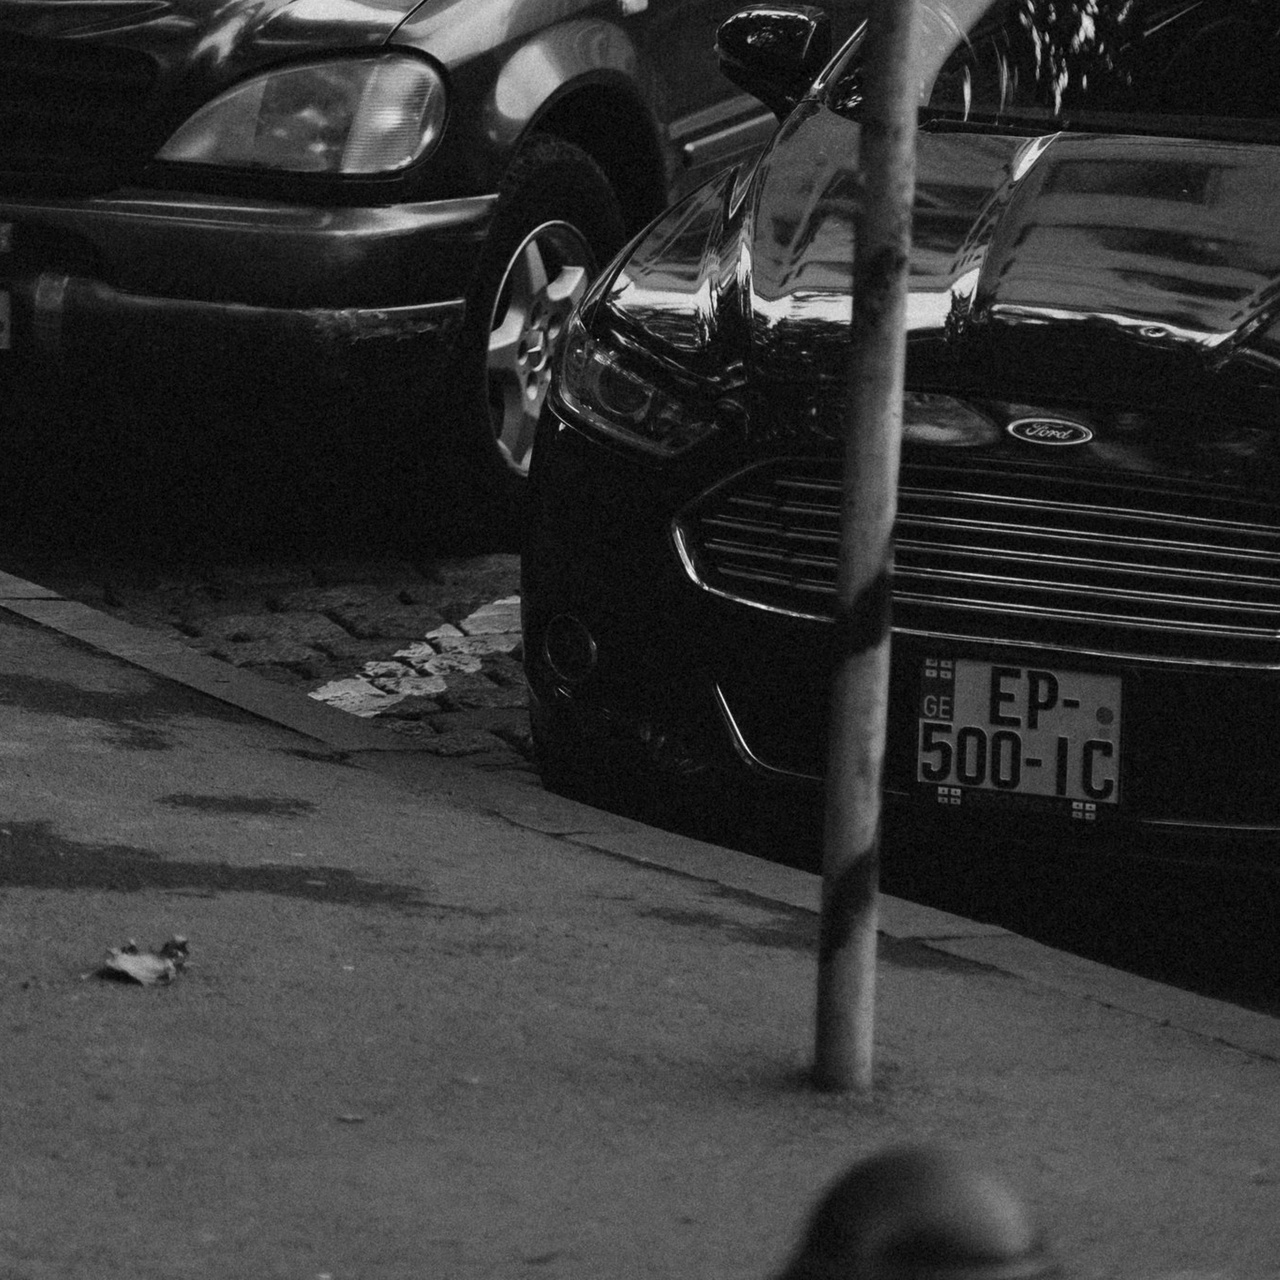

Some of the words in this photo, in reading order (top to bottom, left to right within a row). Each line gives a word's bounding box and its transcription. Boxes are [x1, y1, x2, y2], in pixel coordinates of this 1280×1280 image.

[1024, 422, 1074, 440] Ford
[923, 695, 951, 719] GE
[989, 666, 1080, 729] EP-
[921, 723, 1114, 799] 500-IC
